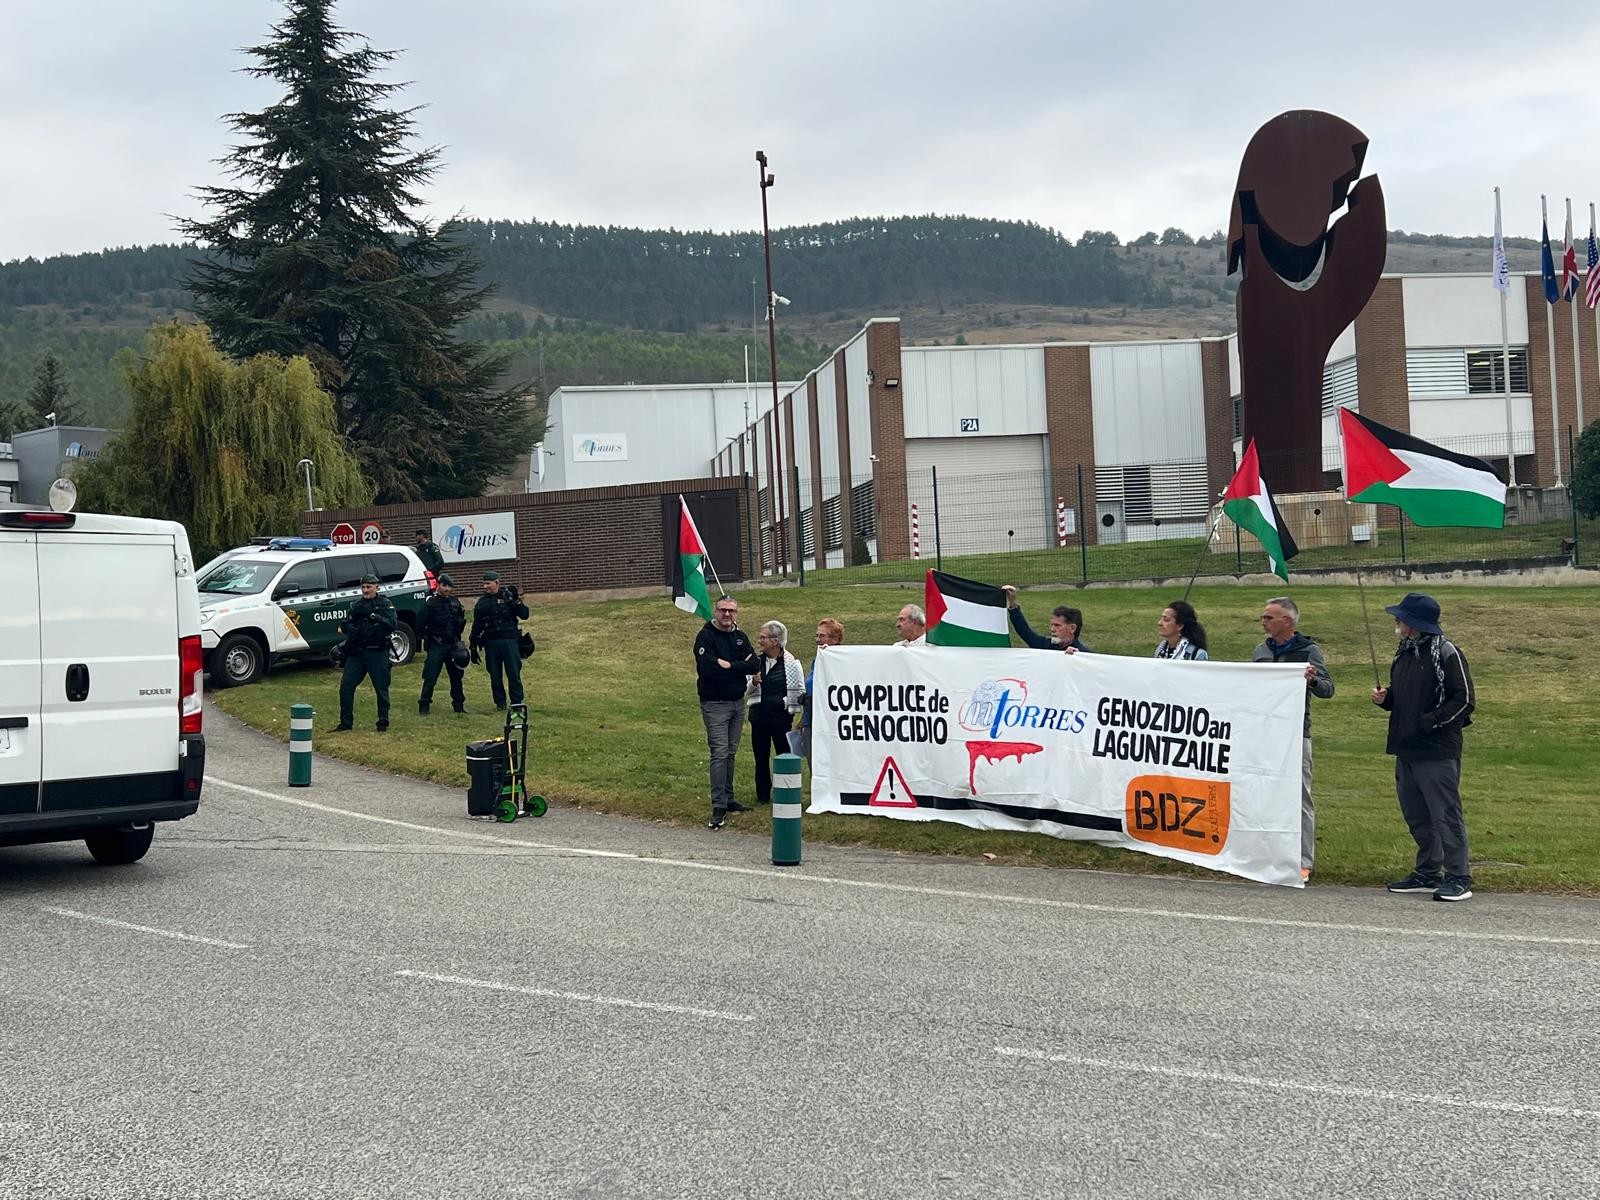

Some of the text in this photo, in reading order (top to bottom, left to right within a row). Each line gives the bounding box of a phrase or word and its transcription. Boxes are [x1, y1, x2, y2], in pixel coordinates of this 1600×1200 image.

[961, 419, 978, 431] P2A
[333, 534, 354, 542] STOP
[364, 531, 379, 541] 20
[314, 609, 347, 622] GUARDI
[139, 688, 172, 696] BOXER
[827, 684, 949, 713] COMPLICE de
[837, 714, 948, 745] GENOCIDIO
[1092, 728, 1231, 774] LAGUNTZAILE
